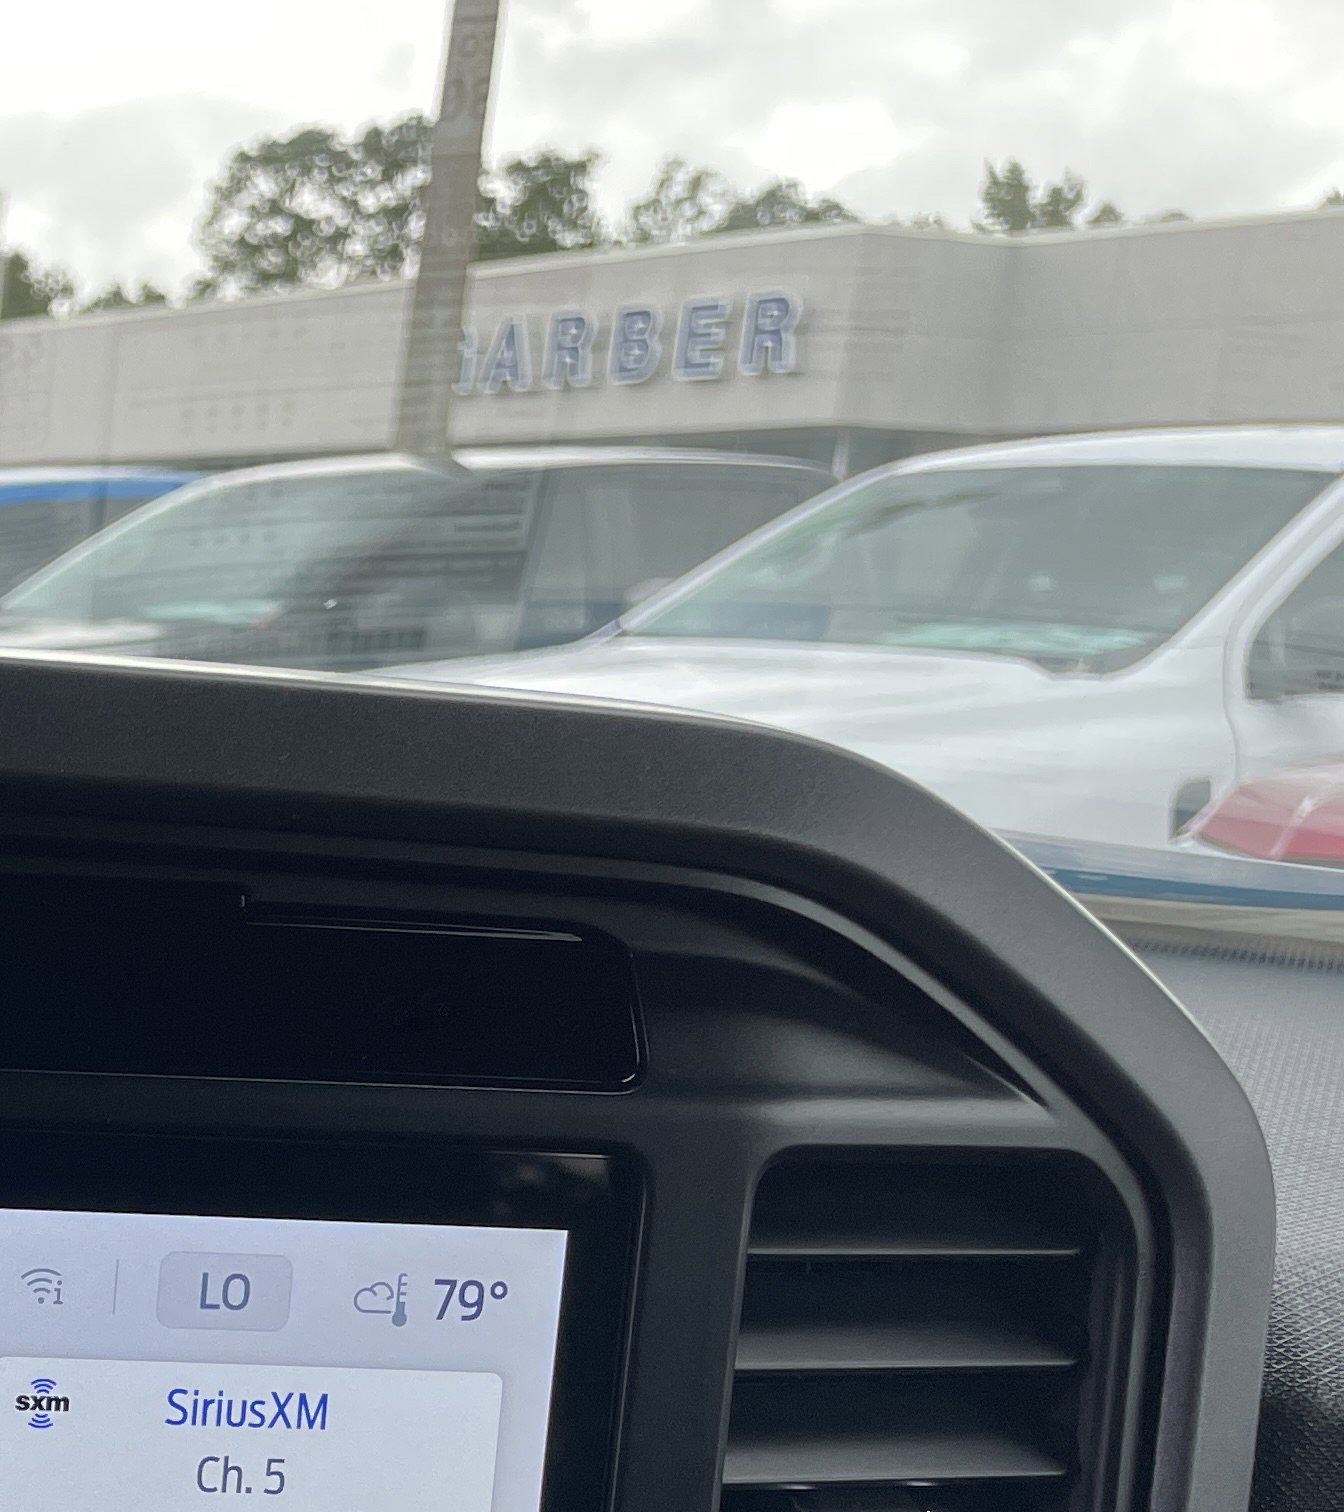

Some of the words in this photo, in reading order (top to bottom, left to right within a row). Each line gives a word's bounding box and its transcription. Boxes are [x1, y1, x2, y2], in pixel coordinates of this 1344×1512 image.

[200, 1273, 250, 1310] LO
[16, 1394, 69, 1413] sxm
[165, 1389, 328, 1430] SiriusXM
[197, 1456, 251, 1493] Ch.
[264, 1459, 285, 1494] 5
